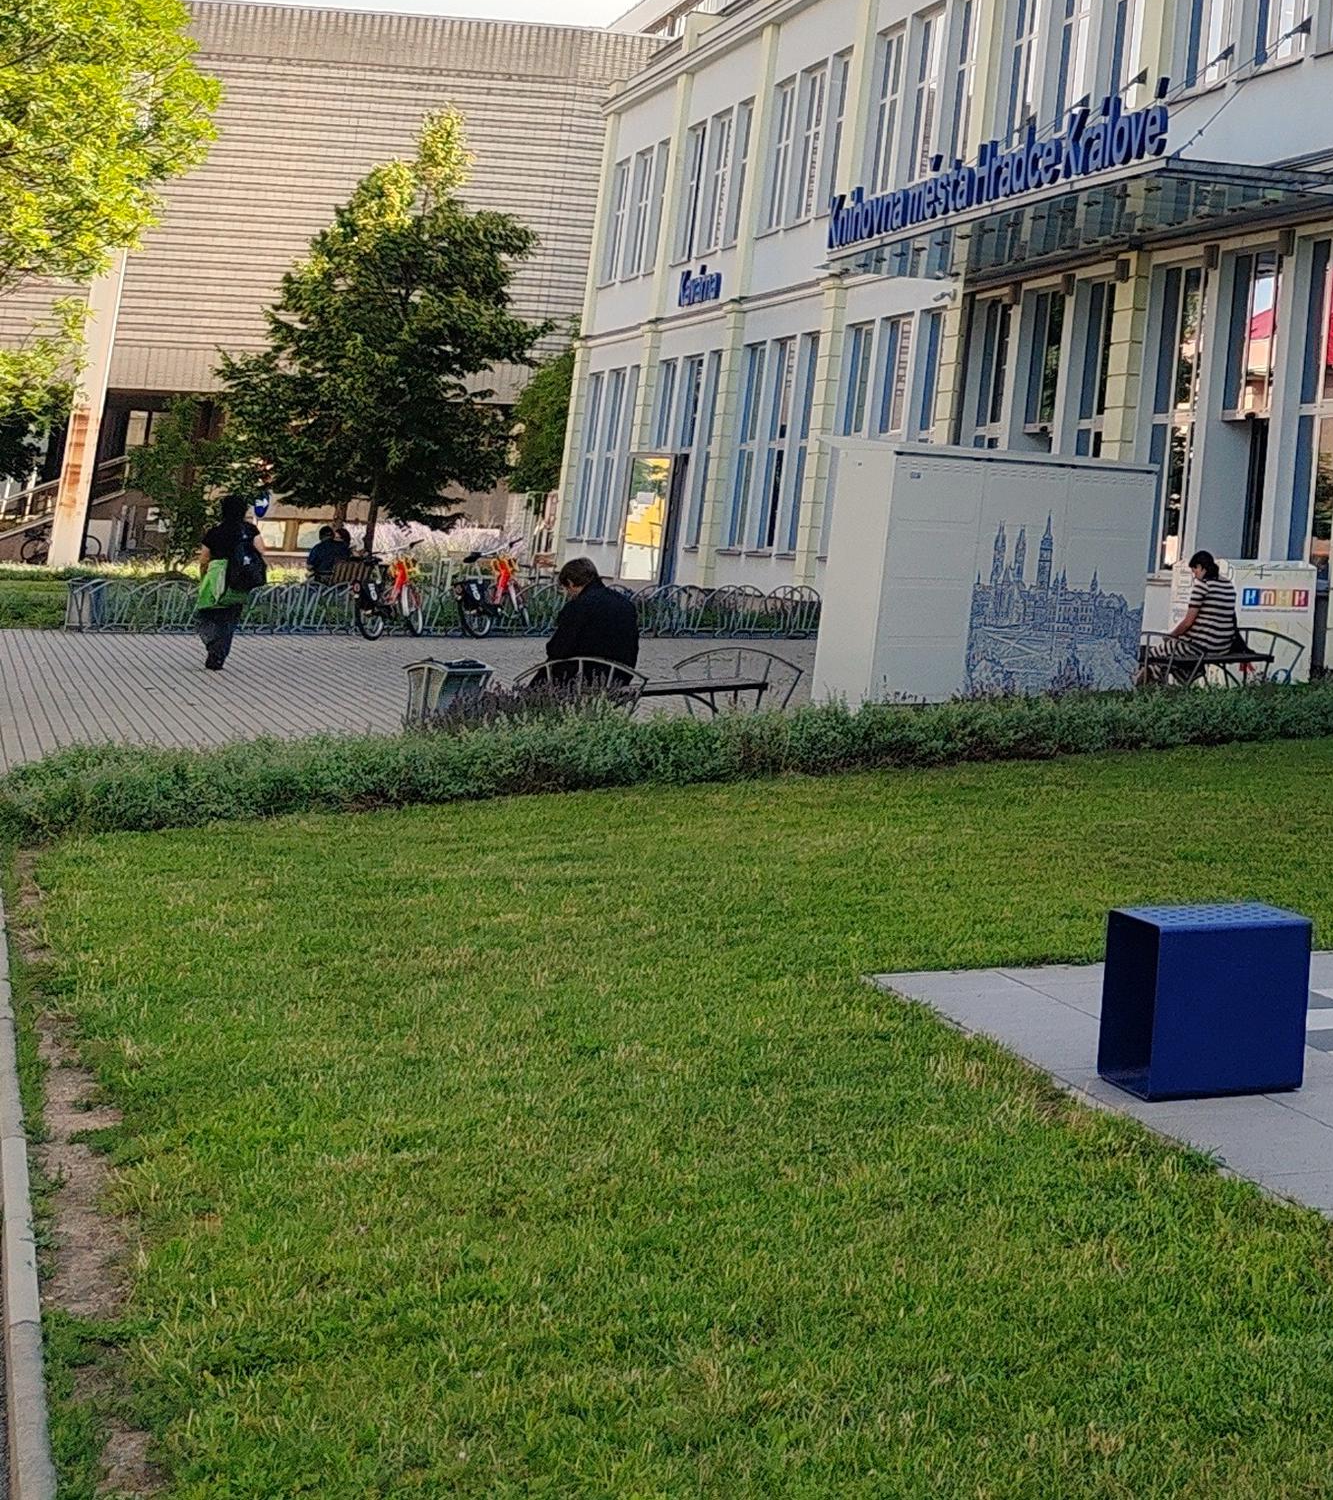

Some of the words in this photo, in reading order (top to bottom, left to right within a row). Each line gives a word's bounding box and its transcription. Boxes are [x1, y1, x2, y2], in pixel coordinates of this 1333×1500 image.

[828, 186, 910, 249] Knihovna
[908, 153, 976, 225] města
[975, 124, 1063, 205] Hradce
[1062, 76, 1171, 180] Králové
[678, 264, 722, 307] Kavárna
